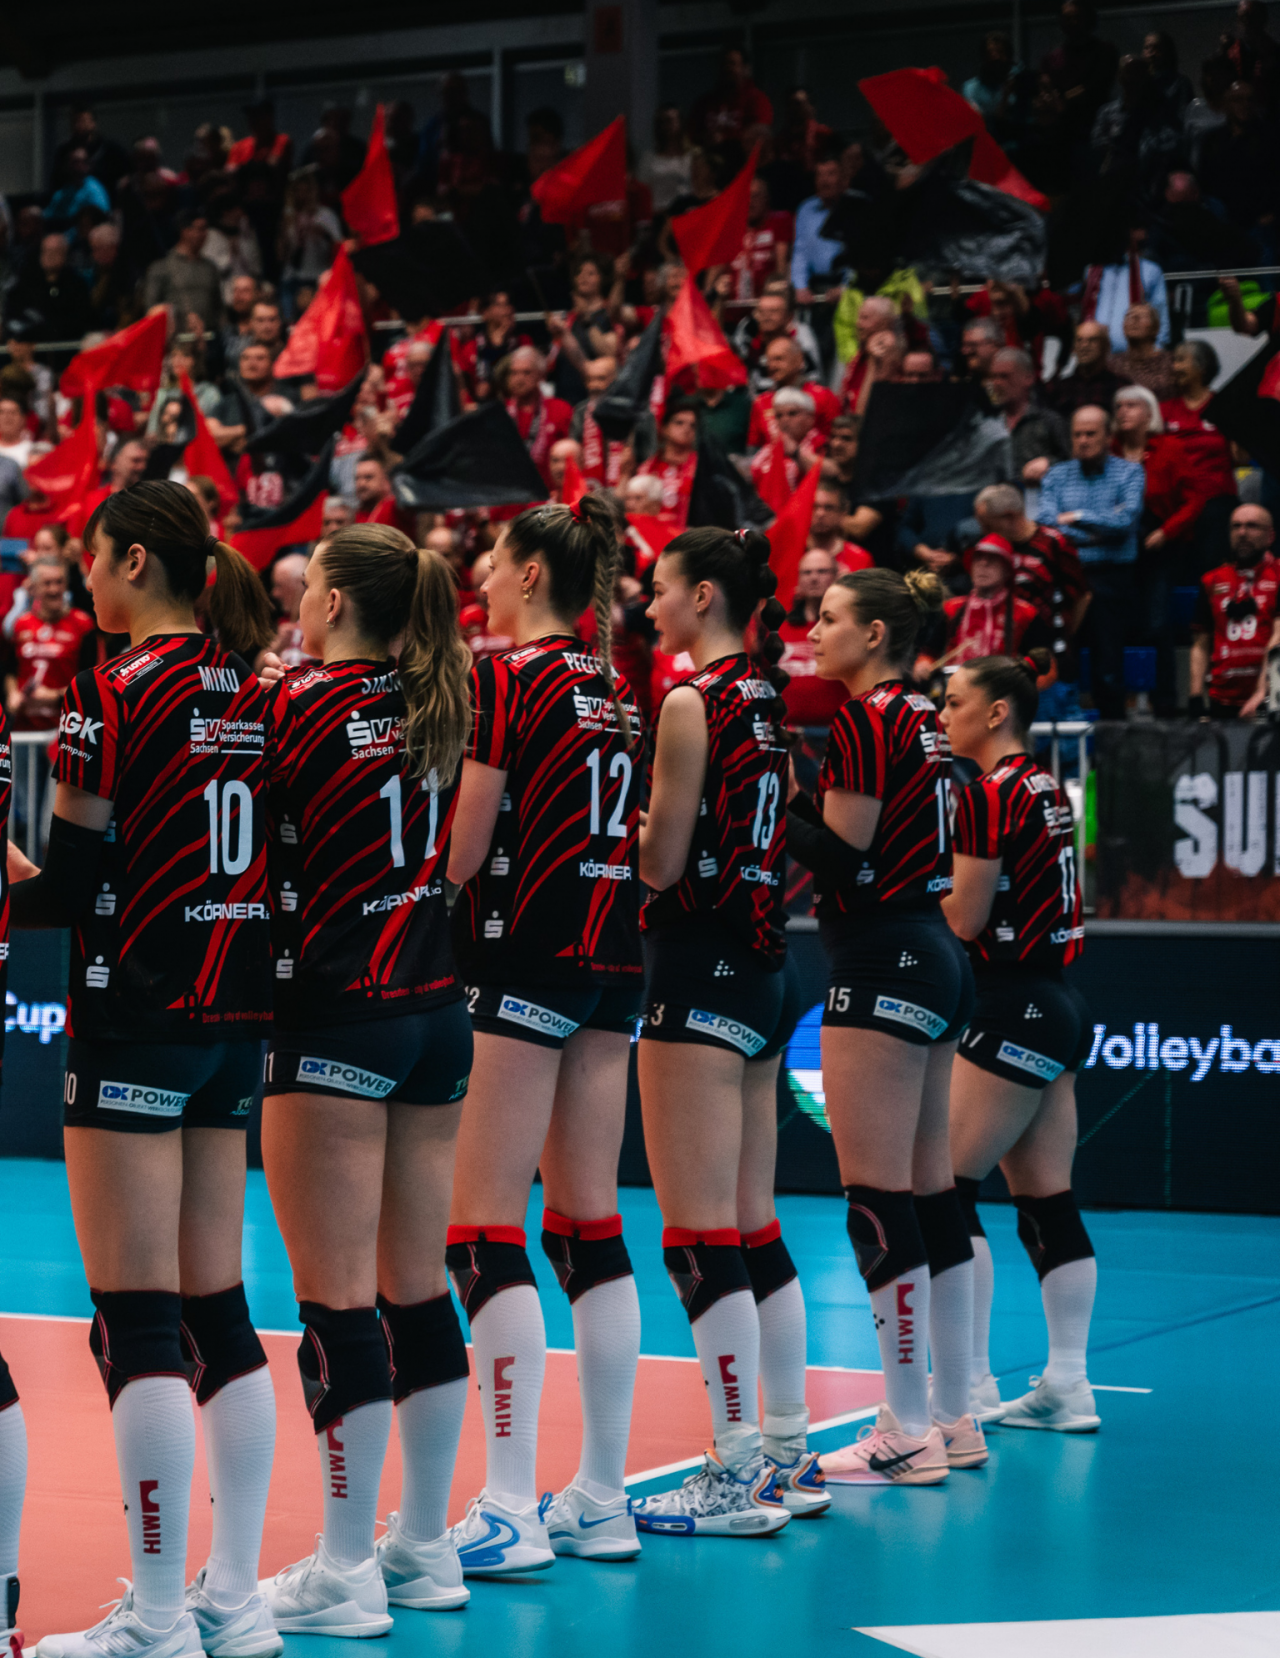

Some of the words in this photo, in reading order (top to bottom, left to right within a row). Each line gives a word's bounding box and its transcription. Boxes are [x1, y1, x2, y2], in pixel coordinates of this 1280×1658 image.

[128, 653, 150, 671] LOTTO
[197, 665, 240, 694] MIKU
[221, 718, 265, 732] Sparkassen
[577, 717, 603, 731] Sachsen
[190, 742, 219, 755] Sachsen
[218, 732, 265, 747] Versicherung
[59, 743, 93, 762] ompany
[351, 745, 395, 760] Sachsen
[586, 748, 632, 838] 12
[379, 768, 439, 868] 11
[752, 771, 780, 850] 13
[204, 778, 253, 875] 10
[1174, 771, 1280, 878] SU
[380, 987, 410, 1000] Dresden
[828, 986, 851, 1012] 15
[329, 1065, 392, 1094] POWER
